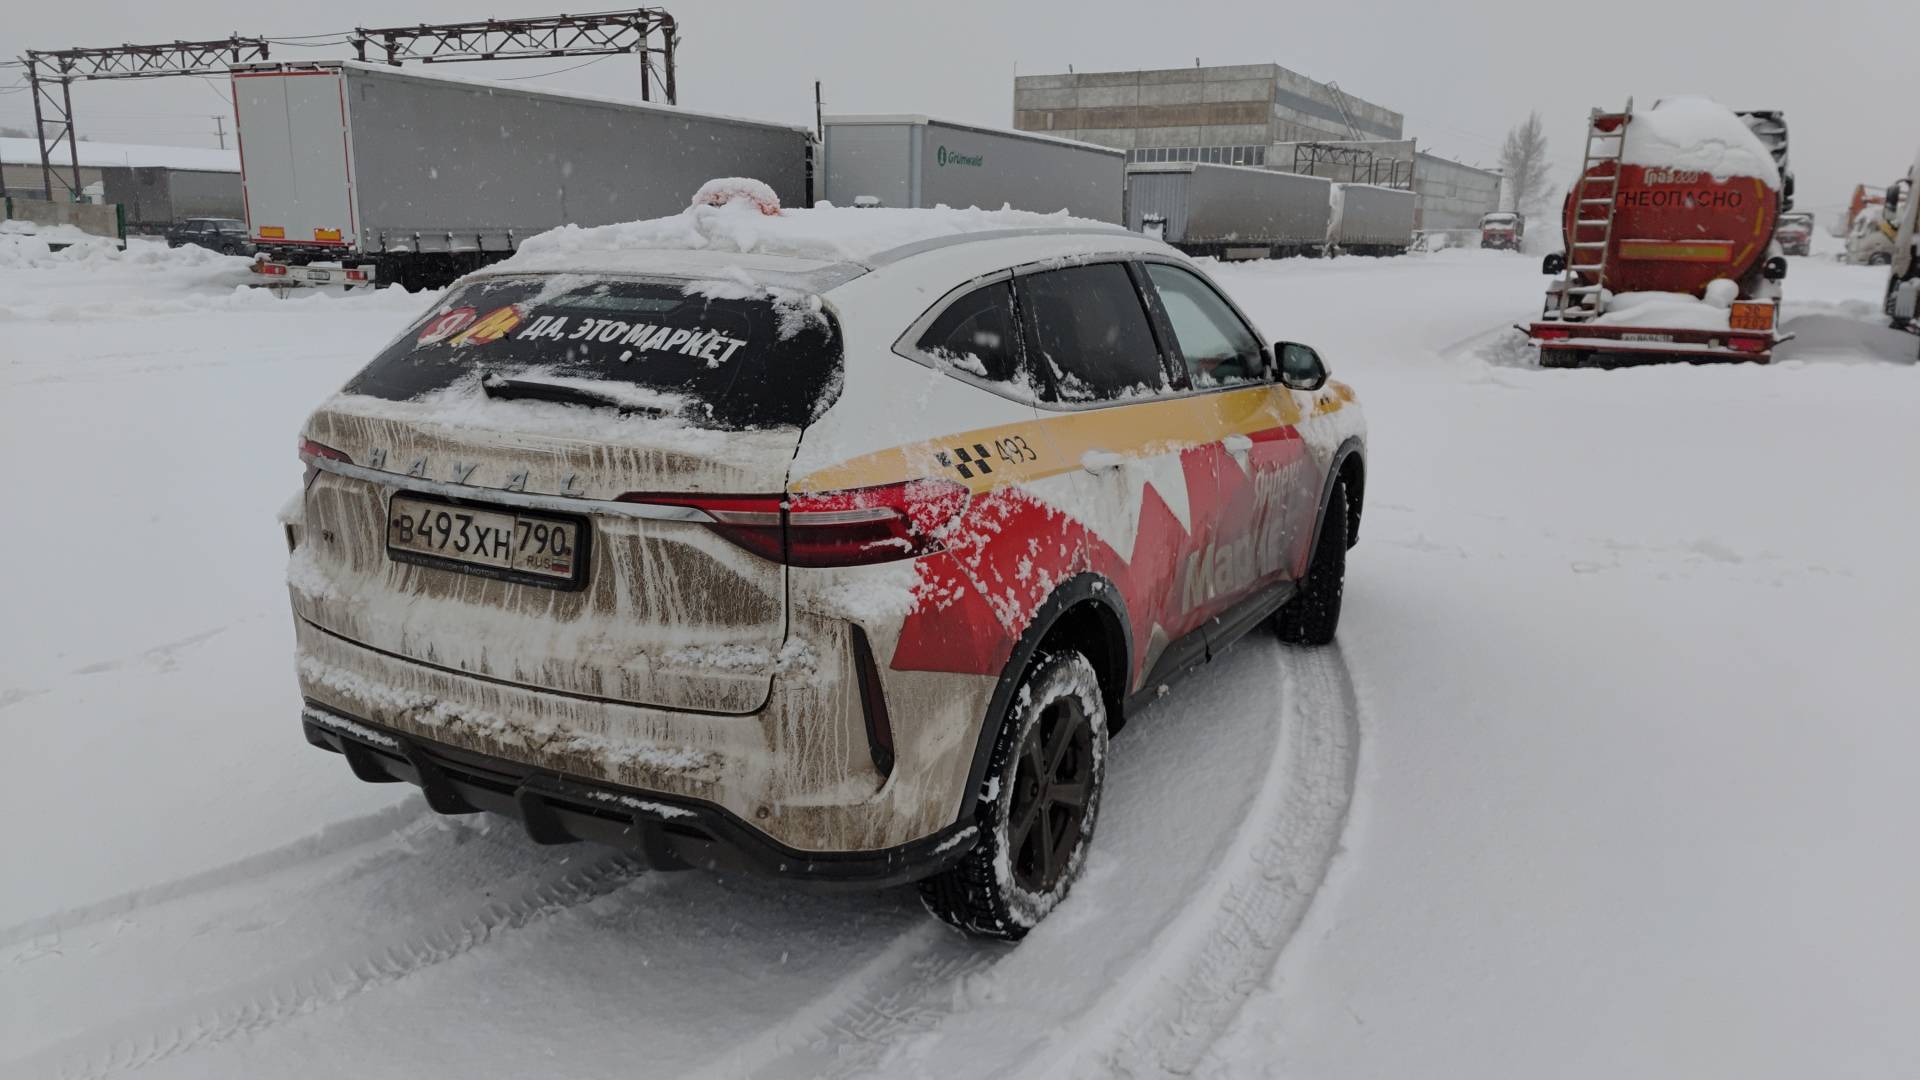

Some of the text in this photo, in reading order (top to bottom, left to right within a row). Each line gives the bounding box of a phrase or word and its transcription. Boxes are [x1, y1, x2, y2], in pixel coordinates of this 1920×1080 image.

[1601, 189, 1743, 208] ГНЕОПАСНО
[516, 315, 566, 342] ДА,
[995, 435, 1037, 465] 493
[526, 555, 552, 569] RUS
